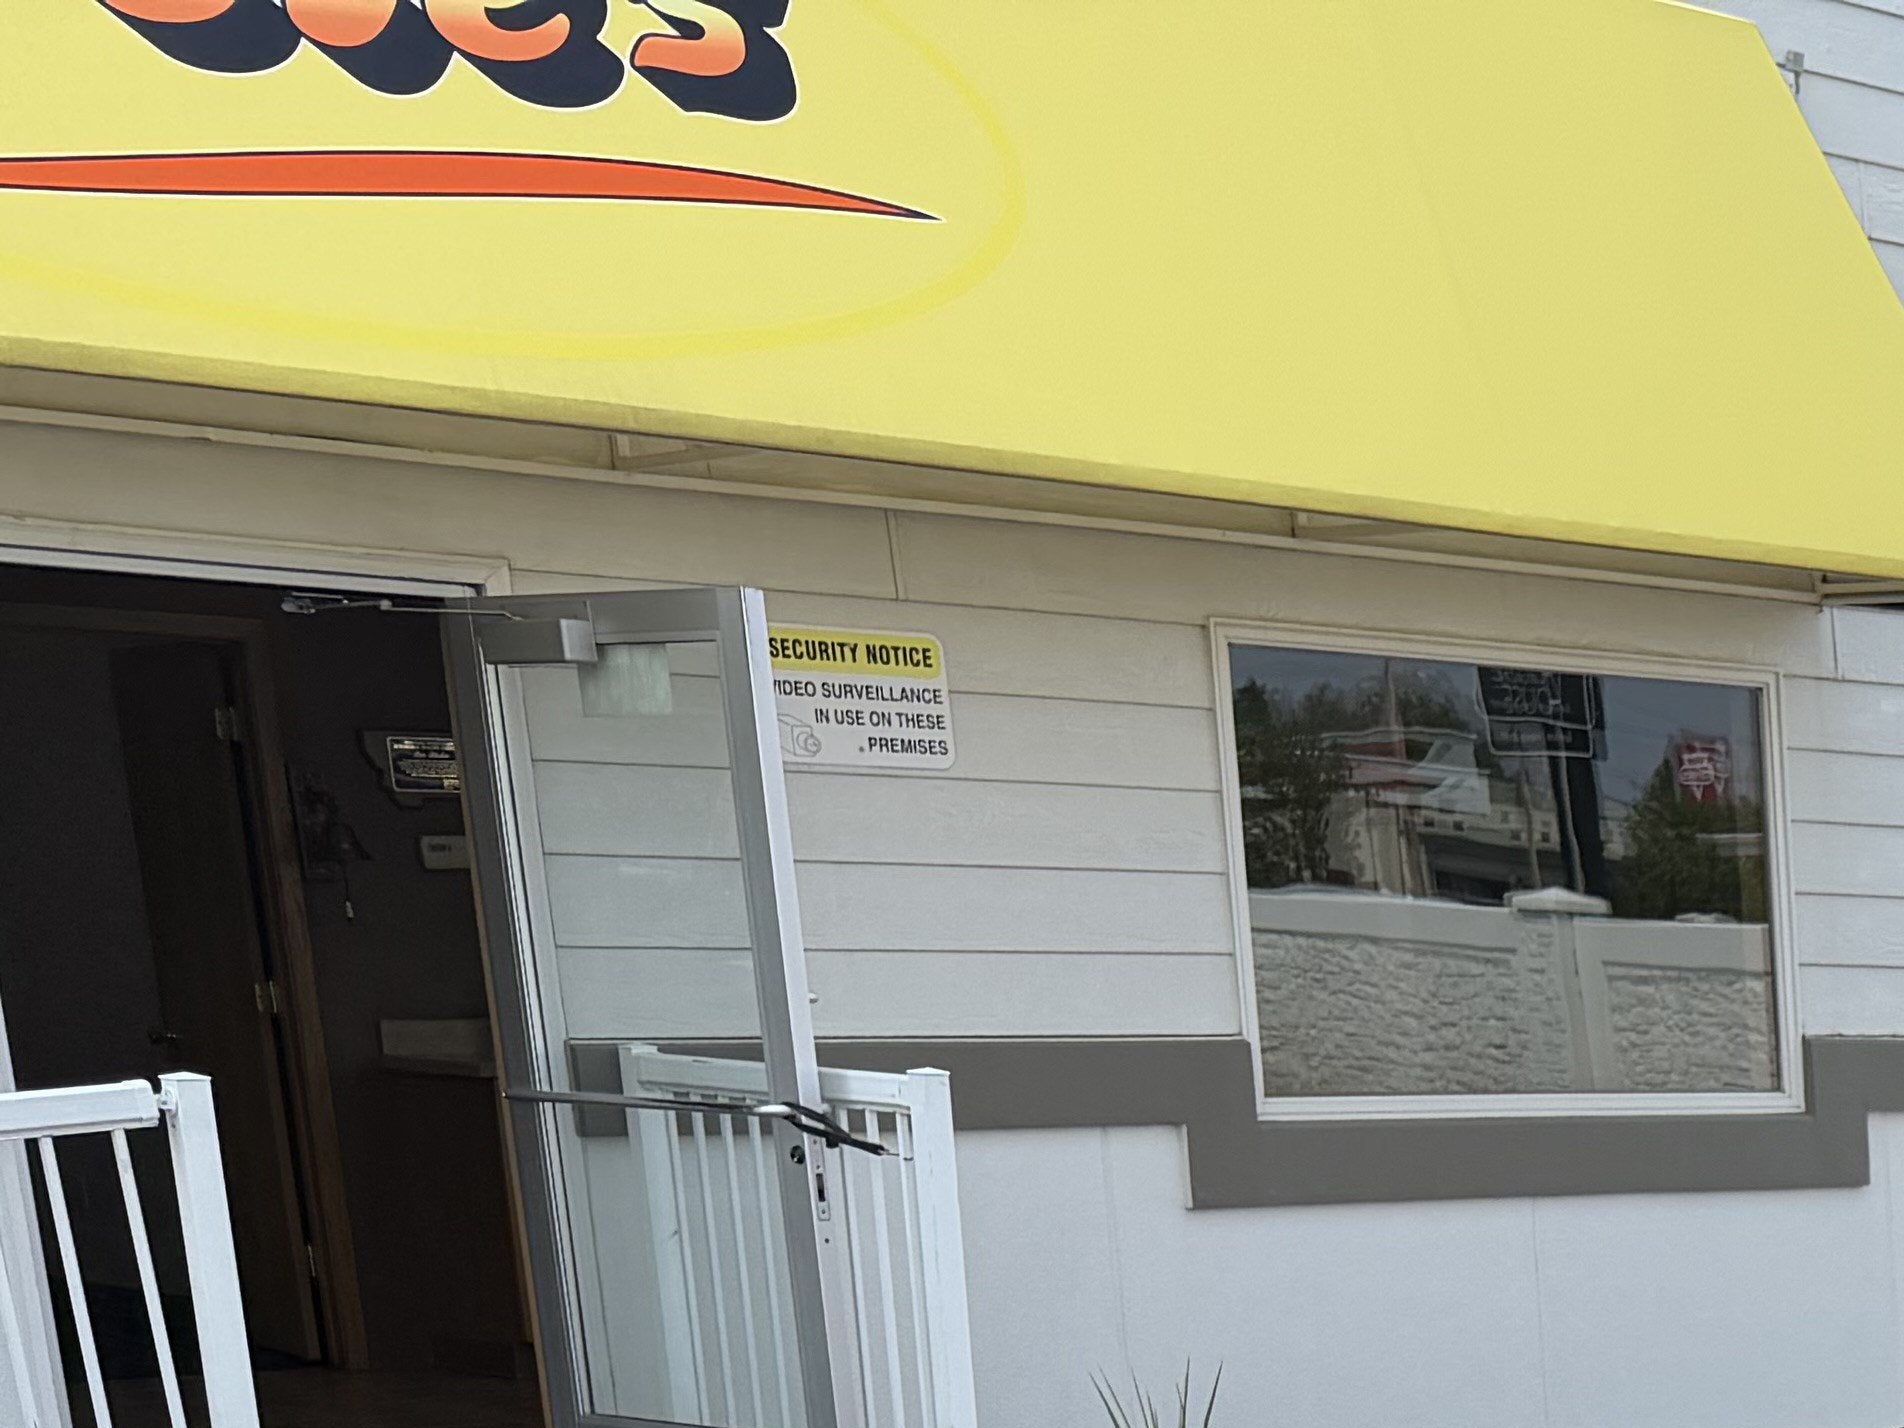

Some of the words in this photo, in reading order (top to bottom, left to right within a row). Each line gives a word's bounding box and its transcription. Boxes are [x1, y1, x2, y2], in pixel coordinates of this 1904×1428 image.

[769, 637, 858, 664] SECURITY
[866, 644, 933, 668] NOTICE
[822, 683, 943, 705] SURVEILLANCE
[815, 708, 830, 724] IN
[834, 709, 865, 726] USE
[869, 711, 892, 727] ON
[895, 712, 946, 730] THESE
[868, 736, 948, 756] PREMISES
